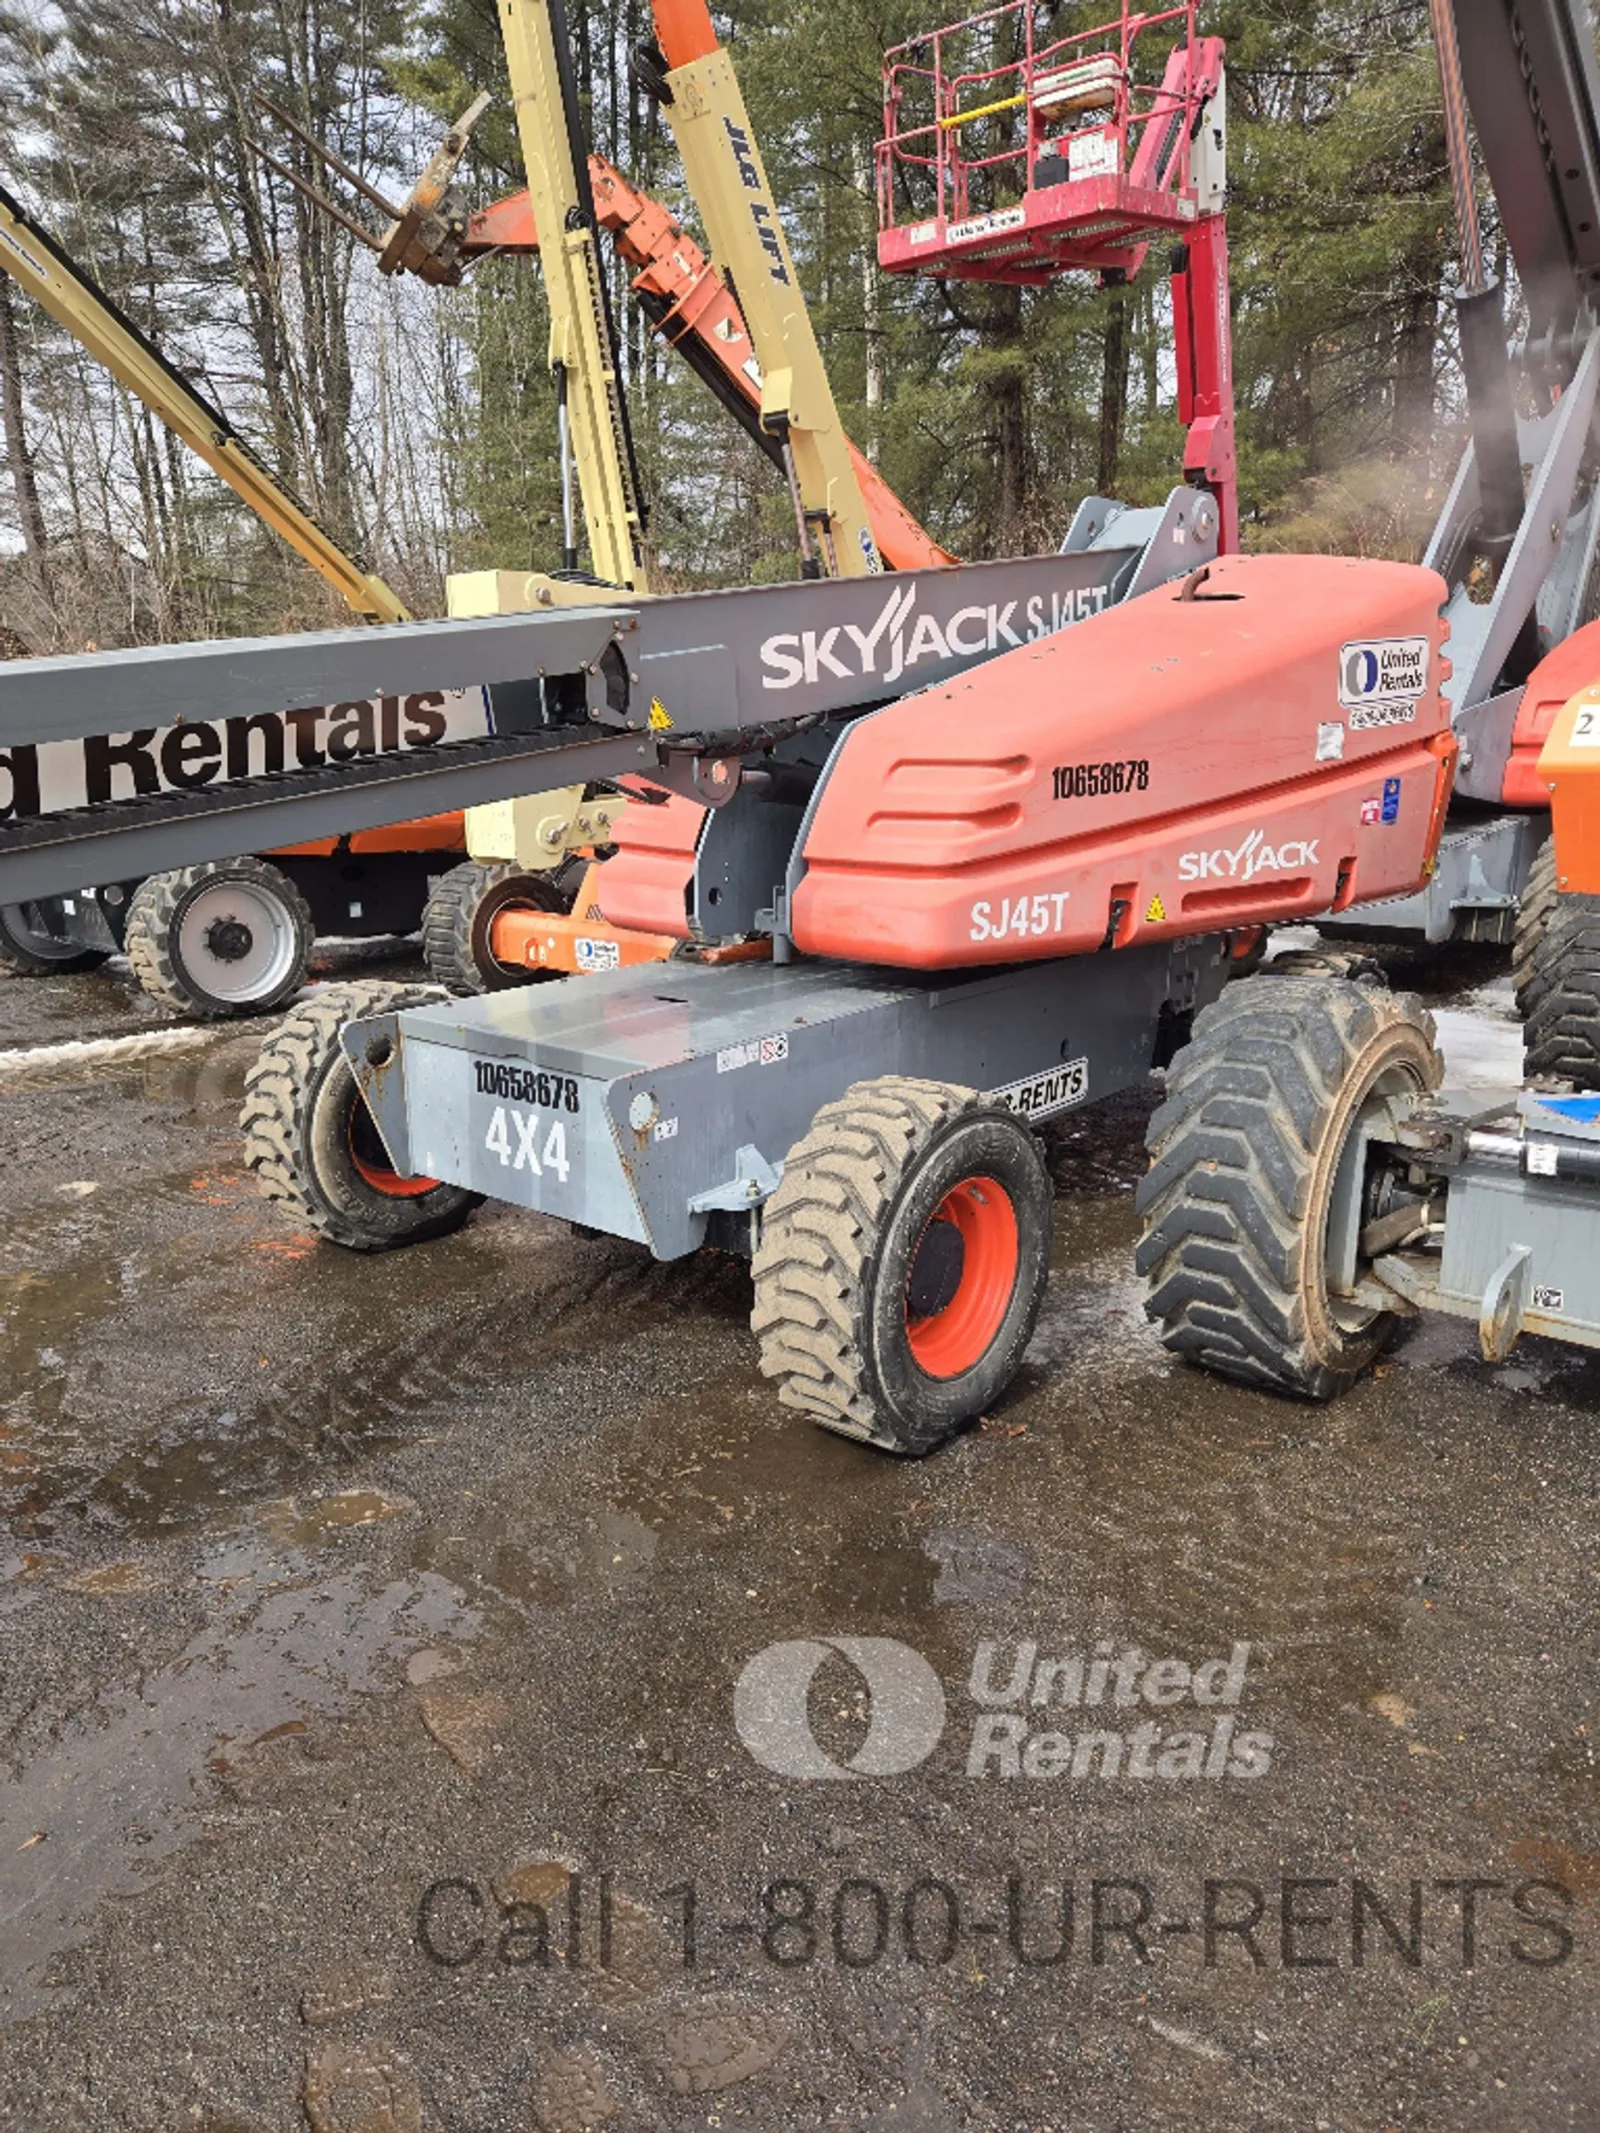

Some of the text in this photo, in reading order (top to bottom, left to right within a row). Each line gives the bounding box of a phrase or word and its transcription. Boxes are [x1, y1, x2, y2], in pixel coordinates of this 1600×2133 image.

[723, 116, 790, 286] JLG LIFT
[760, 581, 1024, 689] SKYJACK
[1381, 646, 1422, 669] United
[1380, 669, 1423, 692] Rentals
[83, 691, 447, 804] Rentals
[1052, 759, 1149, 800] 10658678
[1178, 829, 1320, 881] SKYJACK
[970, 891, 1070, 941] SJ45T
[474, 1060, 579, 1113] 10658678
[485, 1106, 570, 1183] 4X4
